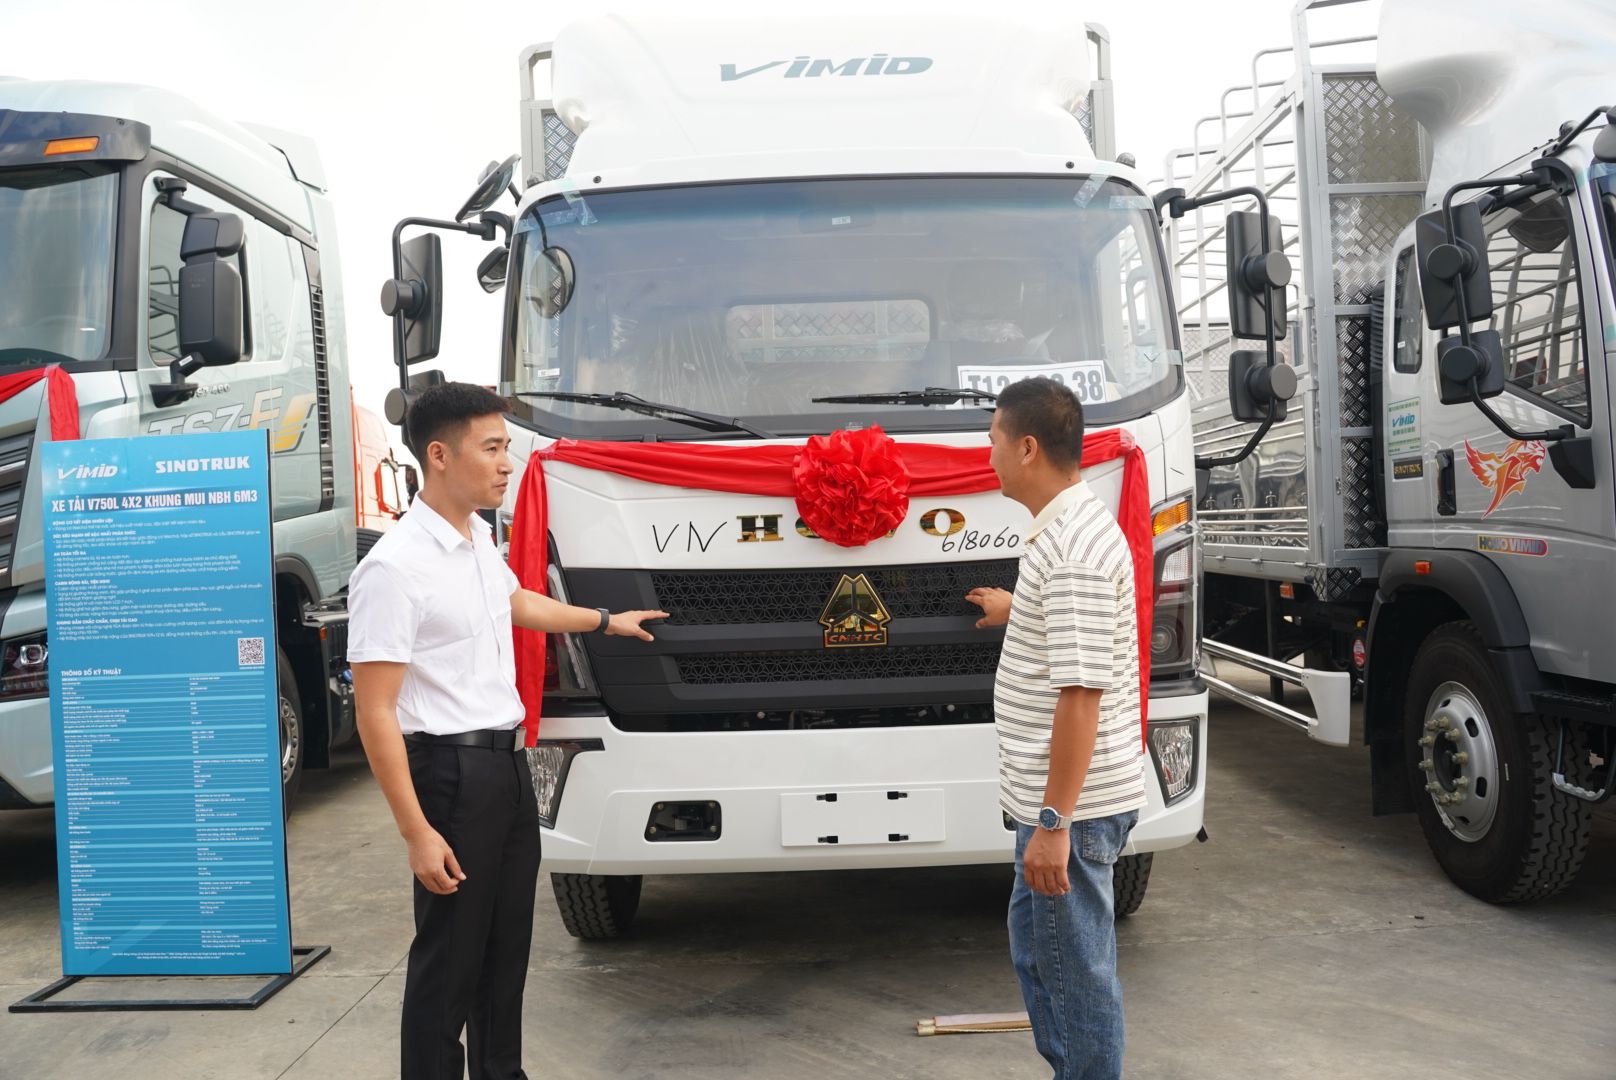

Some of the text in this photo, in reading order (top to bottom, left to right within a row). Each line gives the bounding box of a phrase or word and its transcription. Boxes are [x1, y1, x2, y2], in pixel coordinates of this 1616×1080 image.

[155, 456, 250, 474] SINOTRUK
[52, 490, 258, 512] XE TẢI V750L 4X2 KHUNG MUI NBH 6M3
[1479, 536, 1545, 554] HOWO VIMID
